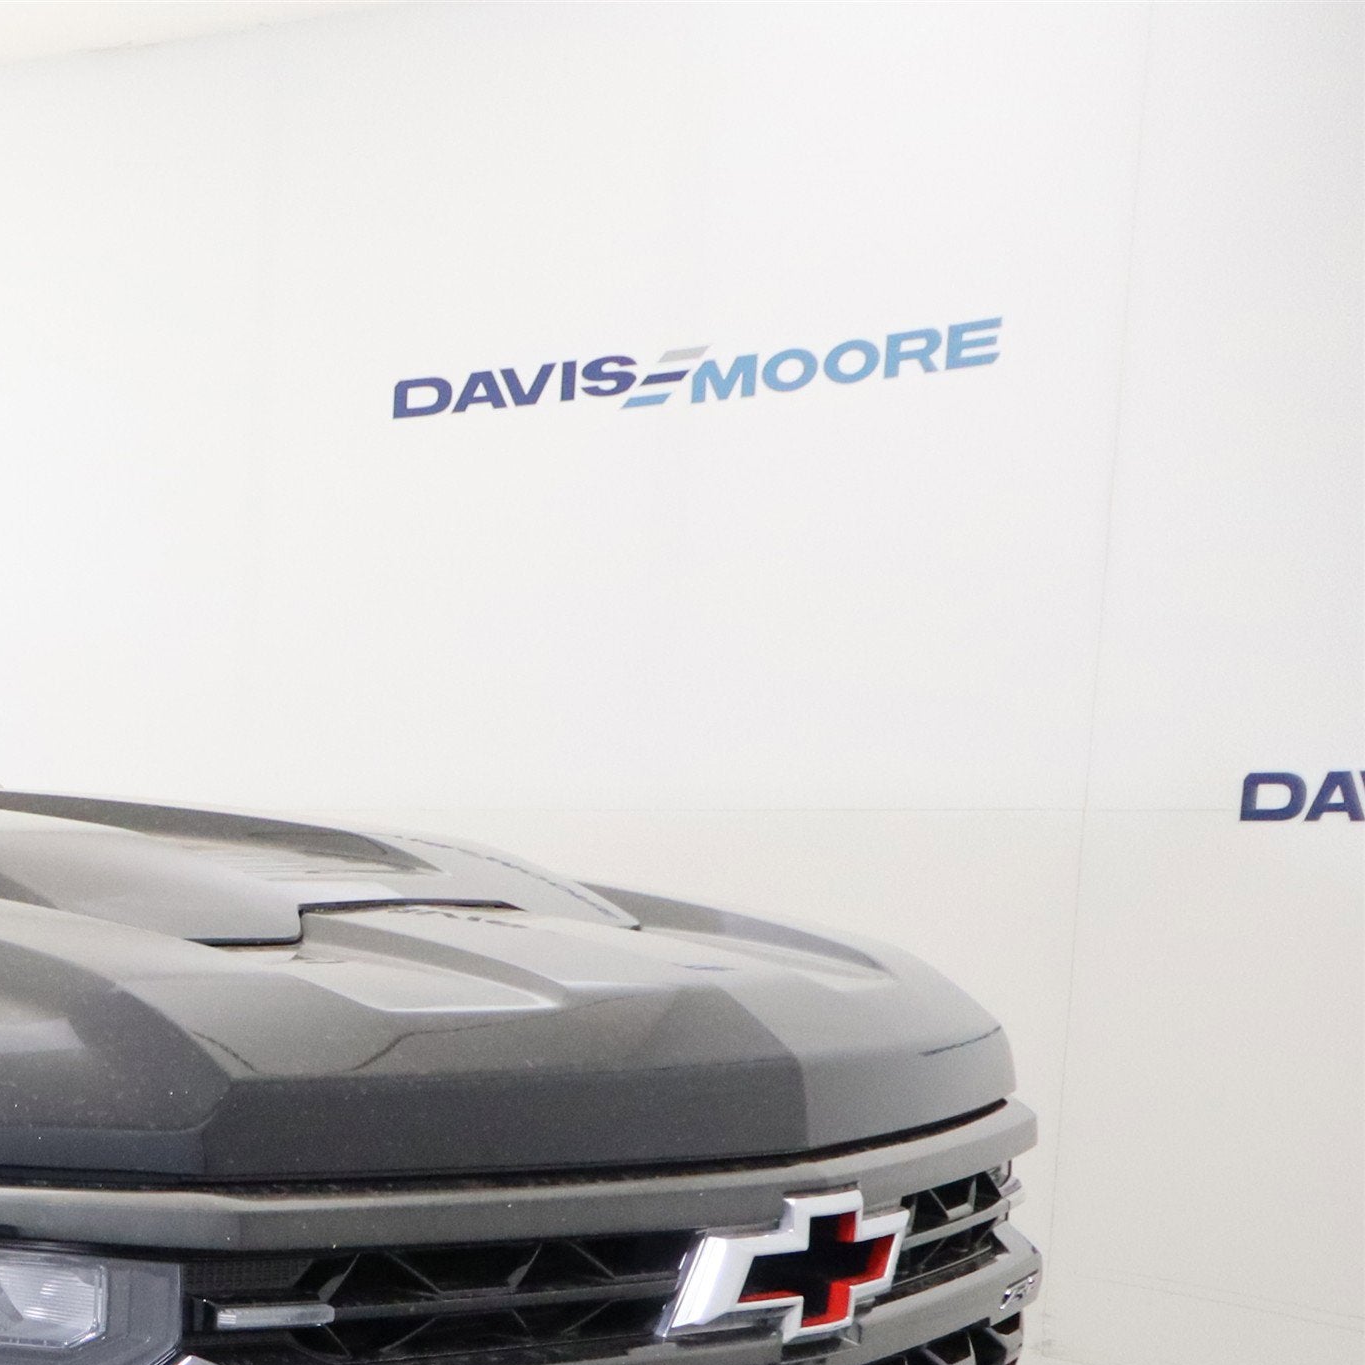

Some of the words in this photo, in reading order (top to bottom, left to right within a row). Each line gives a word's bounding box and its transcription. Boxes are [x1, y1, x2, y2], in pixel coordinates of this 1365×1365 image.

[392, 354, 638, 420] DAVIS
[690, 316, 1003, 403] MOORE
[1239, 770, 1365, 822] DA
